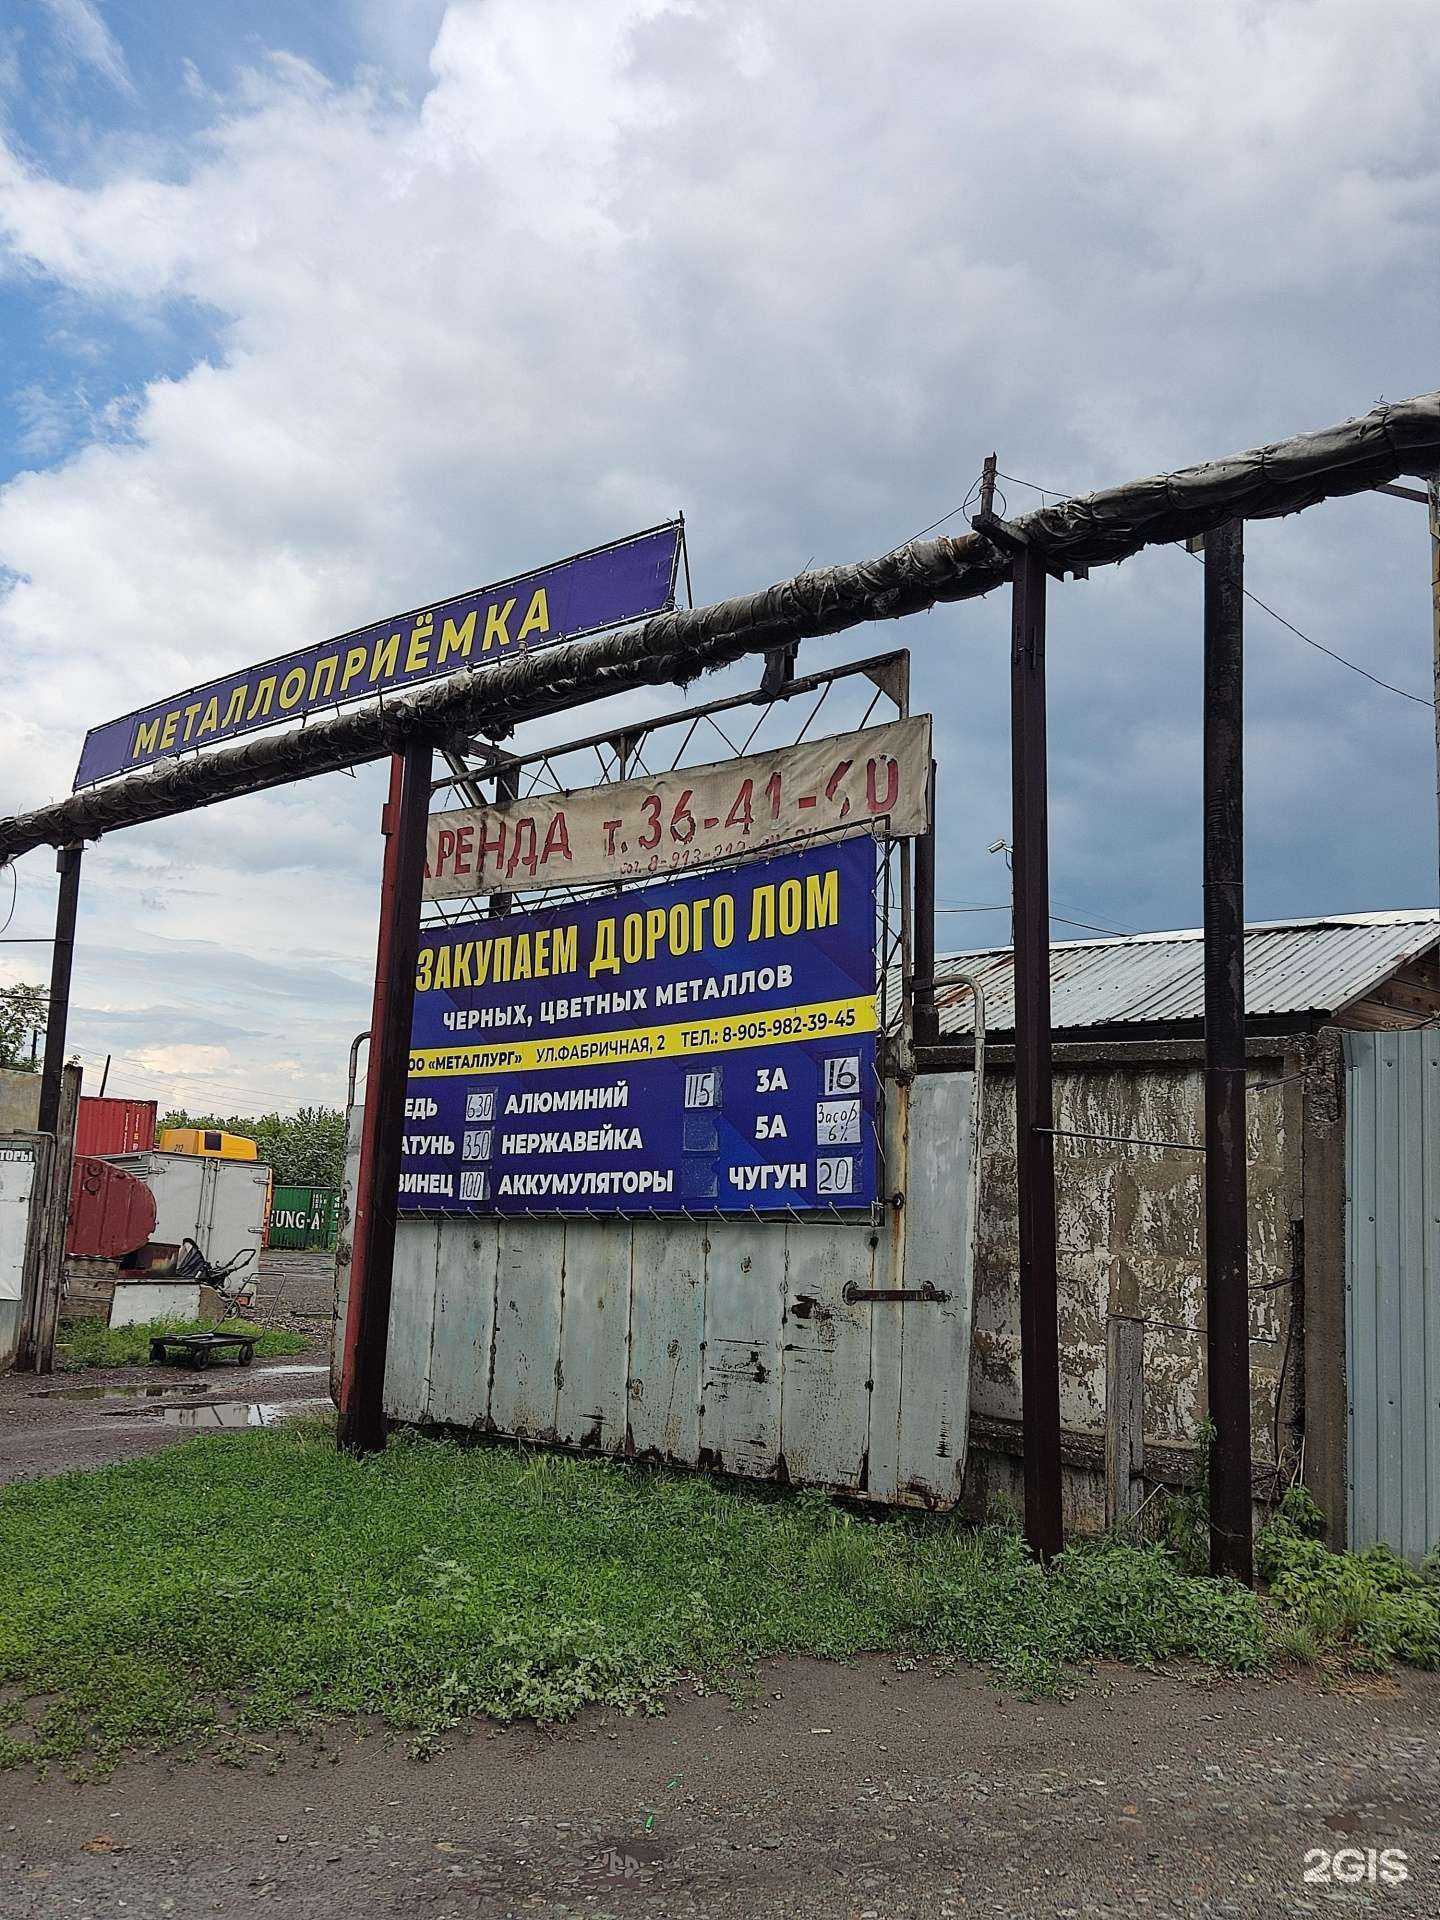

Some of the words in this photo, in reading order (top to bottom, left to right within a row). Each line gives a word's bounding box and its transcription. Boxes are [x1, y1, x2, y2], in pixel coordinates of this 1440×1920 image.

[132, 587, 552, 760] МЕТАЛЛОПРИЁМКА
[415, 924, 579, 993] ЗАКУПАЕМ
[588, 893, 735, 978] ДОРОГО
[747, 870, 840, 942] ЛОМ
[443, 1004, 533, 1031] ЧЕРНЫХ,
[540, 987, 648, 1024] ЦВЕТНЫХ
[656, 964, 793, 1007] МЕТАЛЛОВ
[408, 1057, 425, 1072] ОО
[428, 1050, 522, 1071] «МЕТАЛЛУРГ»
[657, 1035, 666, 1051] 2
[681, 1030, 719, 1048] ТЕЛ.:
[722, 1008, 856, 1043] 8-905-982-39-45
[687, 1075, 712, 1106] 115
[828, 1060, 857, 1092] 16
[404, 1098, 438, 1120] ЕДЬ
[467, 1095, 492, 1118] 630
[504, 1080, 629, 1115] АЛЮМИНИЙ
[401, 1135, 455, 1155] АТУНЬ
[463, 1131, 490, 1159] 350
[501, 1124, 643, 1155] НЕРЖАВЕЙКА
[398, 1173, 454, 1197] ВИНЕЦ
[462, 1173, 483, 1197] 100
[498, 1170, 674, 1195] АККУМУЛЯТОРЫ
[729, 1164, 807, 1191] ЧУГУН
[818, 1159, 849, 1191] 20
